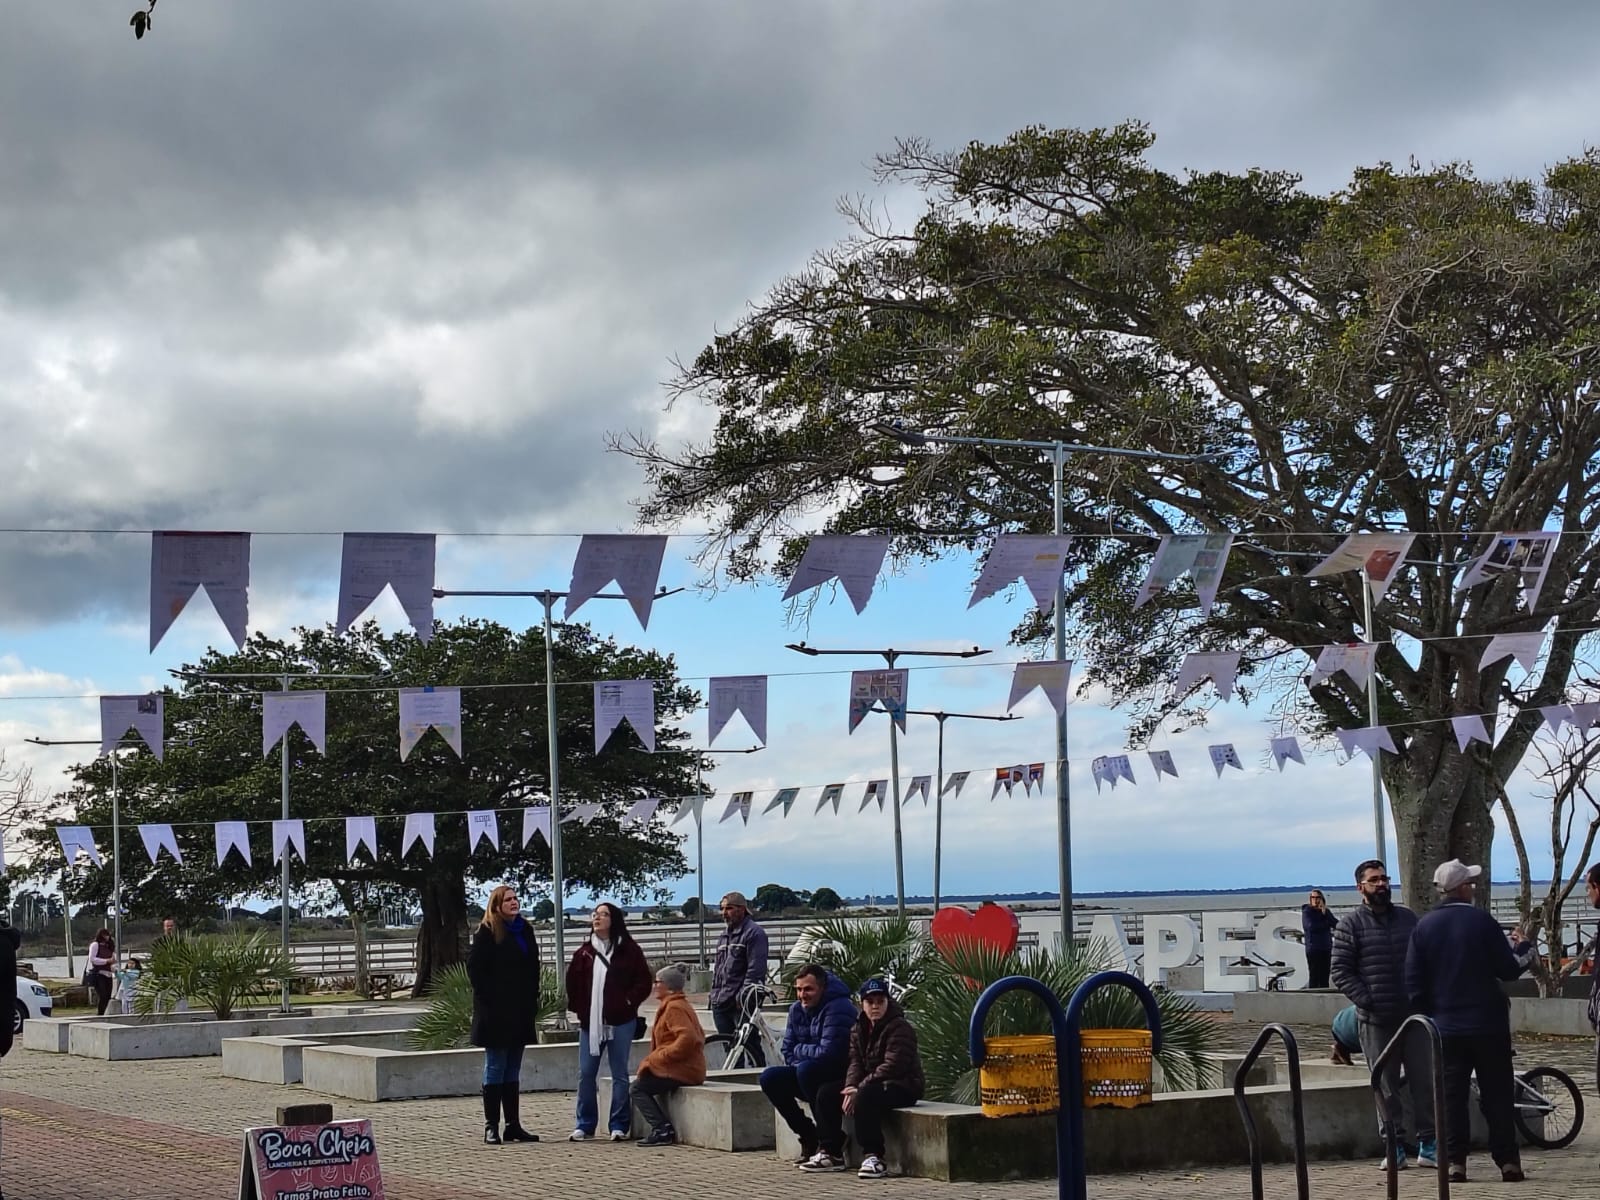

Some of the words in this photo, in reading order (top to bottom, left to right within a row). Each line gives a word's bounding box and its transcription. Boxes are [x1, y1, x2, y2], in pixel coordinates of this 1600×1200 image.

[1019, 910, 1310, 992] TAPES
[259, 1132, 311, 1161] Boca
[319, 1129, 370, 1162] Cheia
[277, 1190, 310, 1200] Temos
[313, 1188, 340, 1199] Prato
